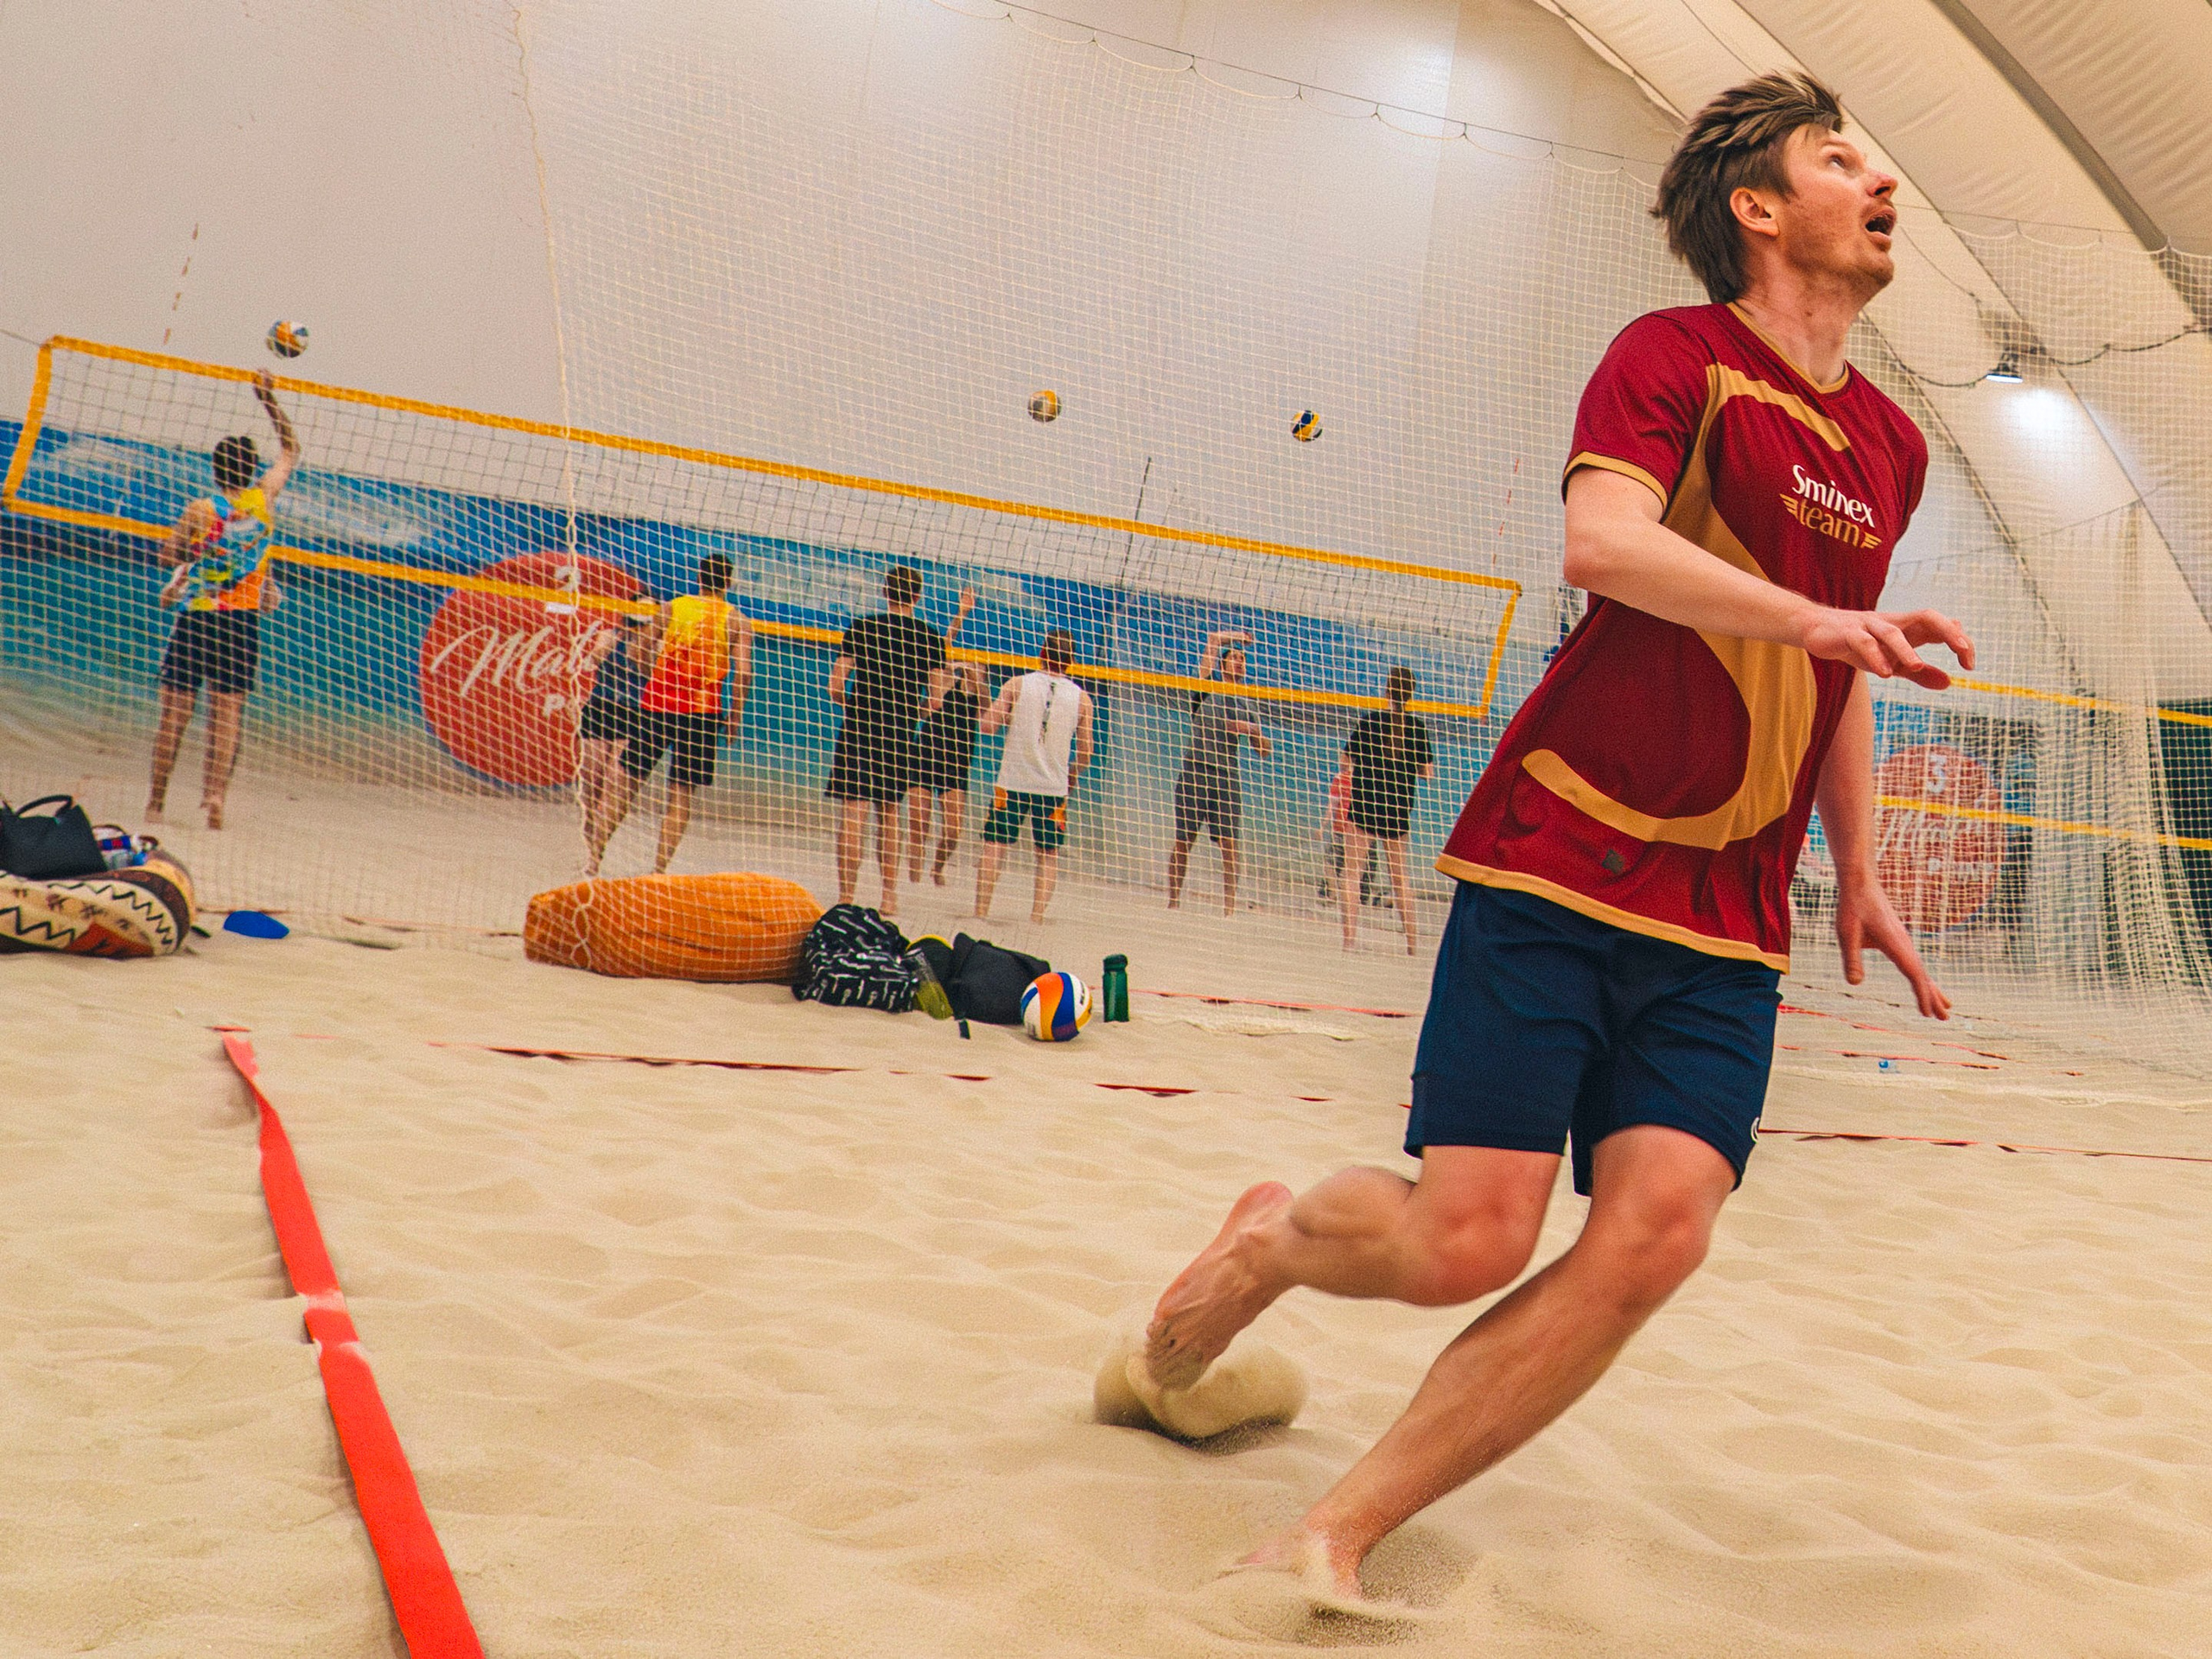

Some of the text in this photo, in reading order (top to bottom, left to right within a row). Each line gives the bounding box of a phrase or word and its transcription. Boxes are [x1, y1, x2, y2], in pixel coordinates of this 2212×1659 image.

[1791, 464, 1876, 528] Sminex
[1798, 499, 1860, 547] team
[1926, 753, 1947, 793] 3
